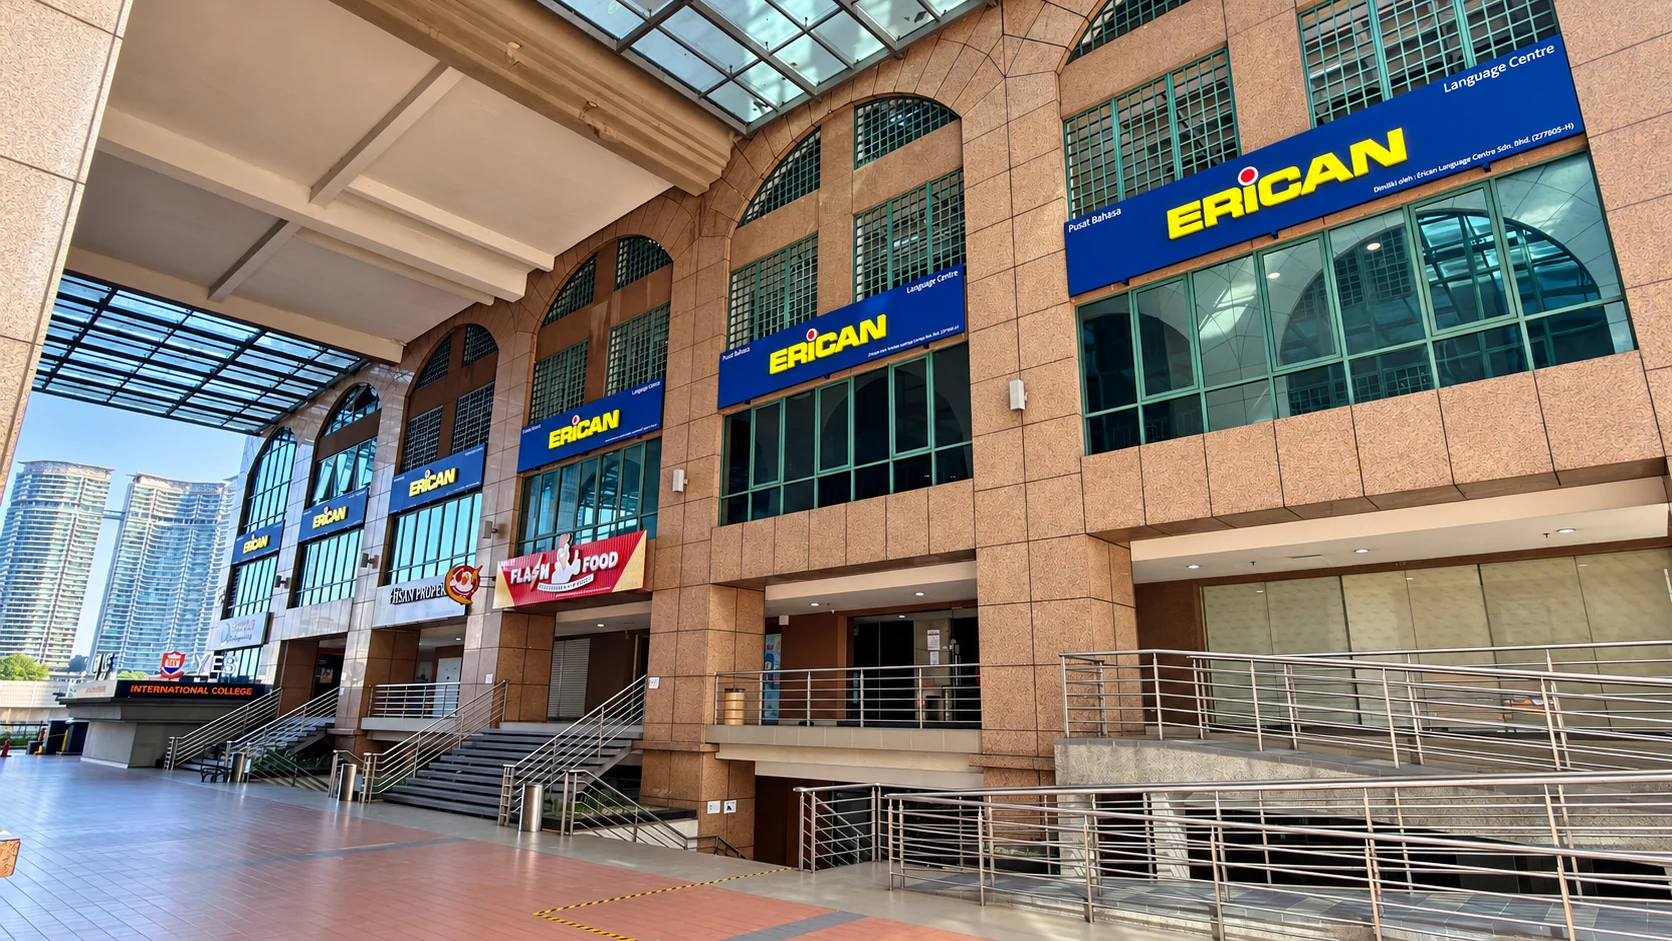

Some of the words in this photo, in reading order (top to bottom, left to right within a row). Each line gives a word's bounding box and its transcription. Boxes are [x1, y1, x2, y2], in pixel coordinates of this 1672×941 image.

[1443, 63, 1507, 93] Language
[1508, 44, 1555, 69] Centre
[1373, 181, 1398, 194] Dimiliki
[1398, 175, 1413, 186] oleh
[1416, 167, 1438, 179] Erican
[1438, 156, 1471, 170] Language
[1471, 149, 1496, 161] Centre
[1496, 143, 1514, 153] Sdn.
[1068, 218, 1091, 233] Pusat
[1091, 207, 1122, 225] Bahasa
[906, 278, 937, 294] Language
[936, 270, 959, 283] Centre
[510, 560, 551, 587] FLASH
[582, 551, 619, 573] FOOD
[130, 684, 209, 695] INTERNATIONAL
[211, 686, 253, 696] COLLEGE
